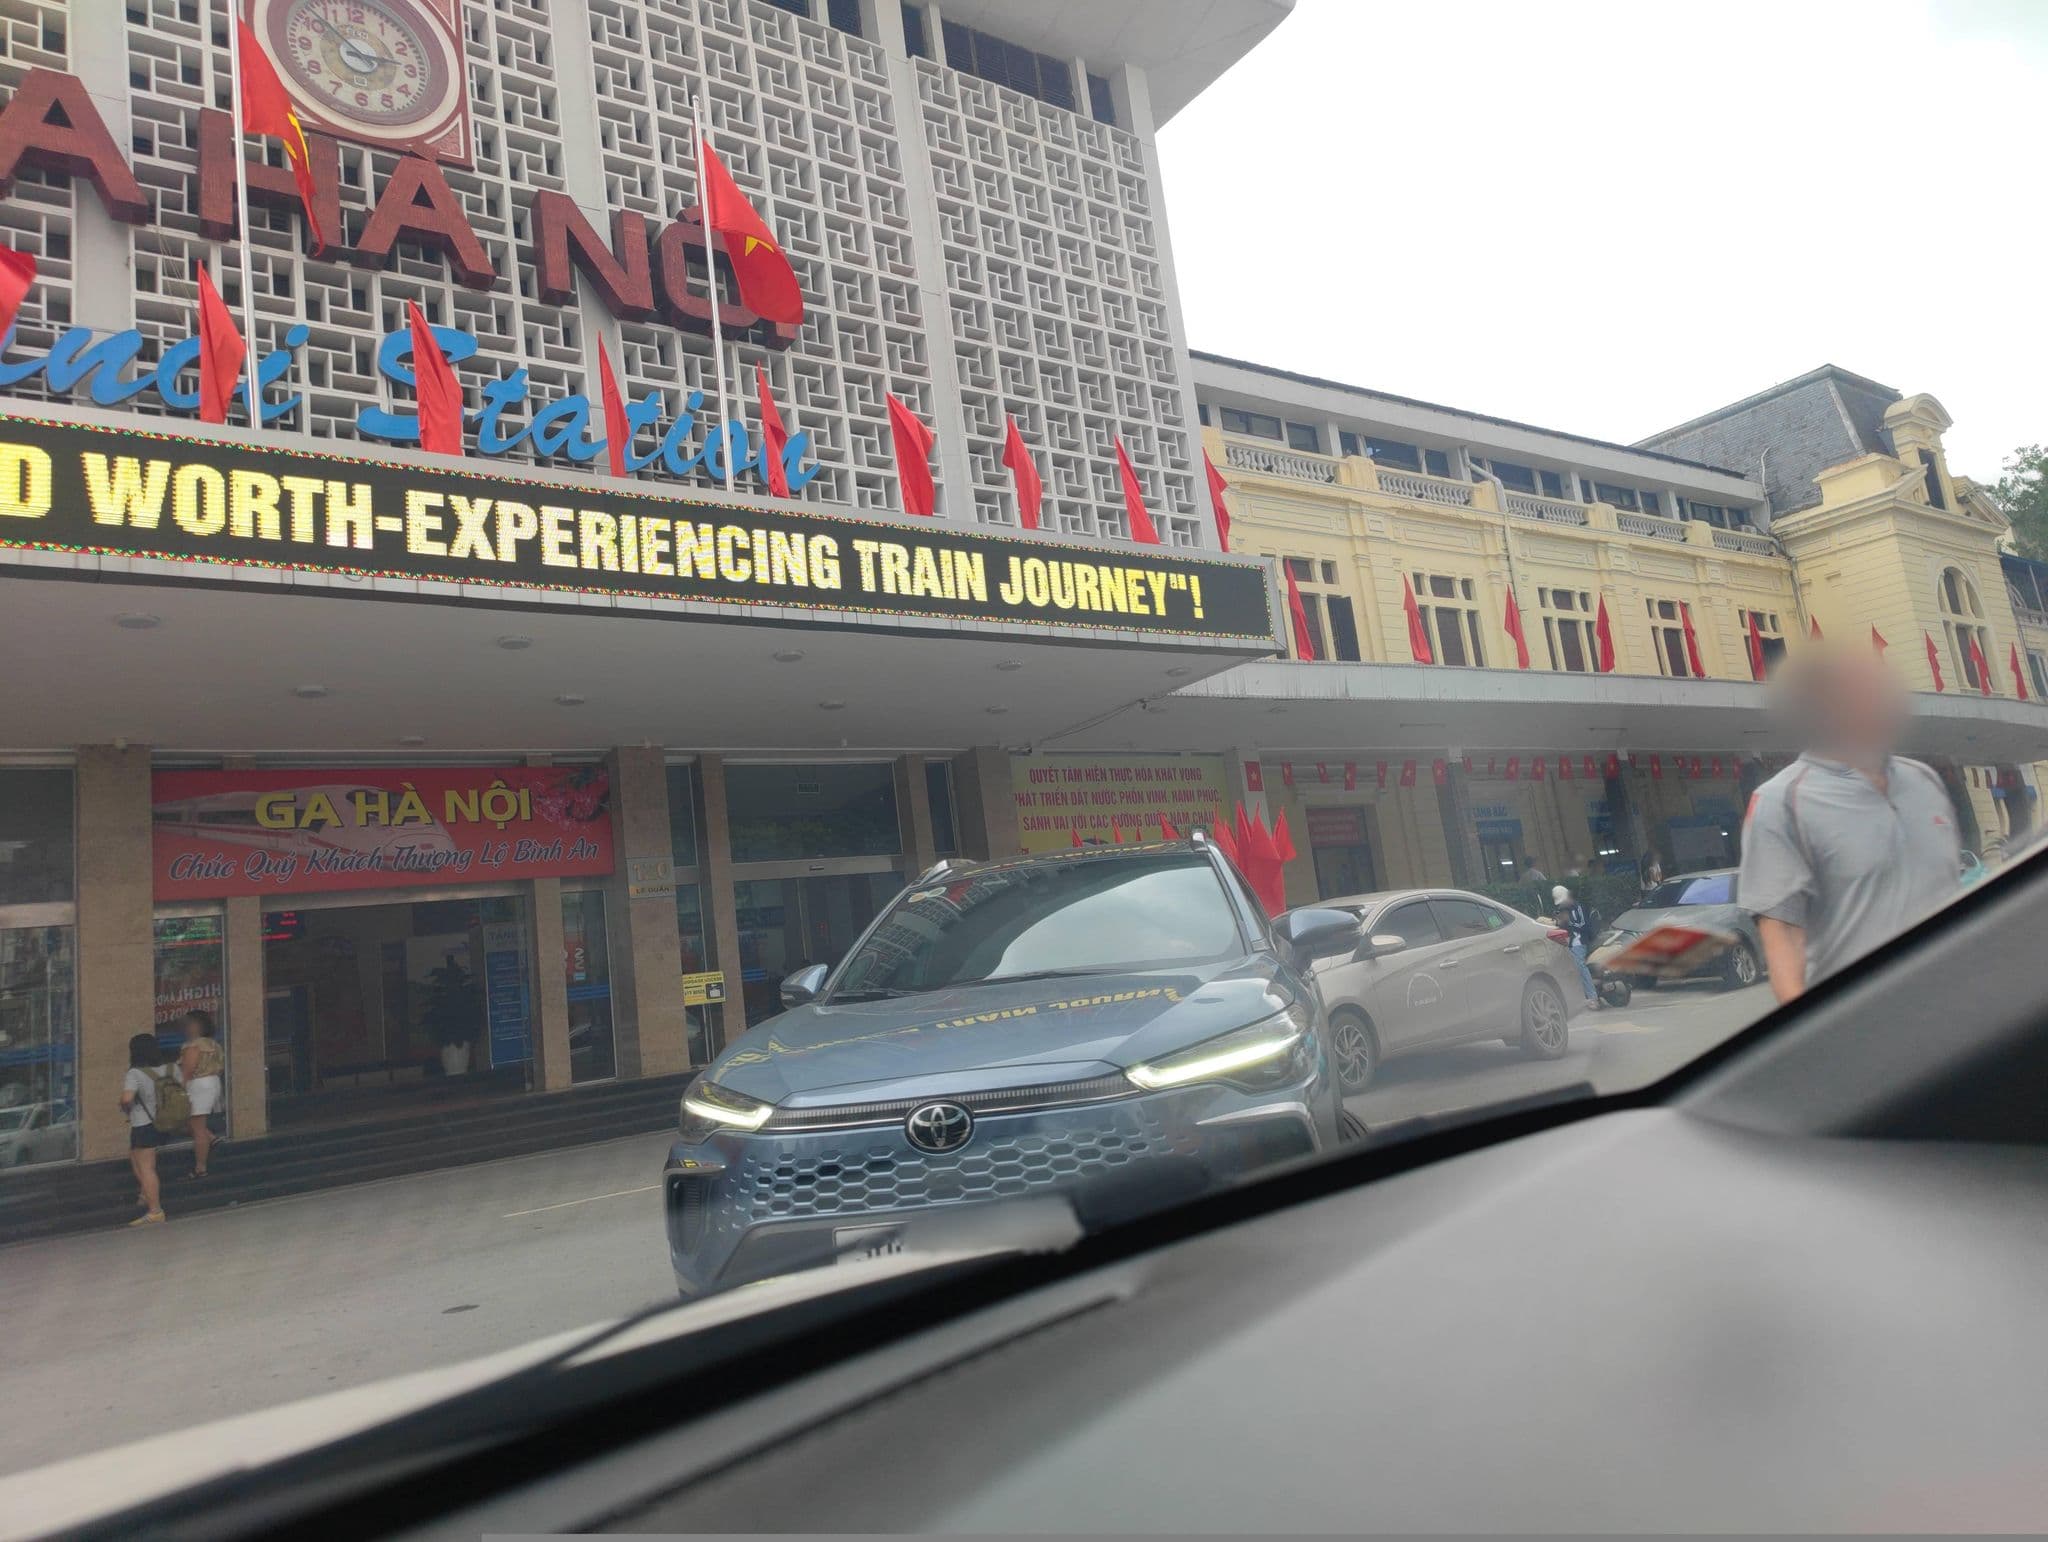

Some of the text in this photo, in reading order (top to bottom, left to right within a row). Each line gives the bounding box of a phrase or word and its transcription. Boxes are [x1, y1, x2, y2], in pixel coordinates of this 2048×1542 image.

[346, 8, 365, 24] 12
[304, 16, 325, 34] 10
[379, 22, 386, 36] 1
[298, 36, 312, 51] 9
[394, 41, 408, 57] 2
[307, 60, 321, 75] 8
[404, 64, 417, 79] 3
[329, 80, 343, 95] 7
[397, 83, 411, 97] 4
[354, 92, 368, 107] 6
[381, 93, 394, 108] 5
[82, 452, 842, 589] WORTH-EXPERIENCING
[853, 540, 988, 601] TRAIN
[1084, 765, 1107, 784] HIỆN
[255, 780, 533, 830] GA HÀ NỘI
[1053, 815, 1070, 830] VAI
[1089, 812, 1109, 829] CÁC
[169, 836, 600, 883] Chúc Quý Khách Thượng Lộ Bình An
